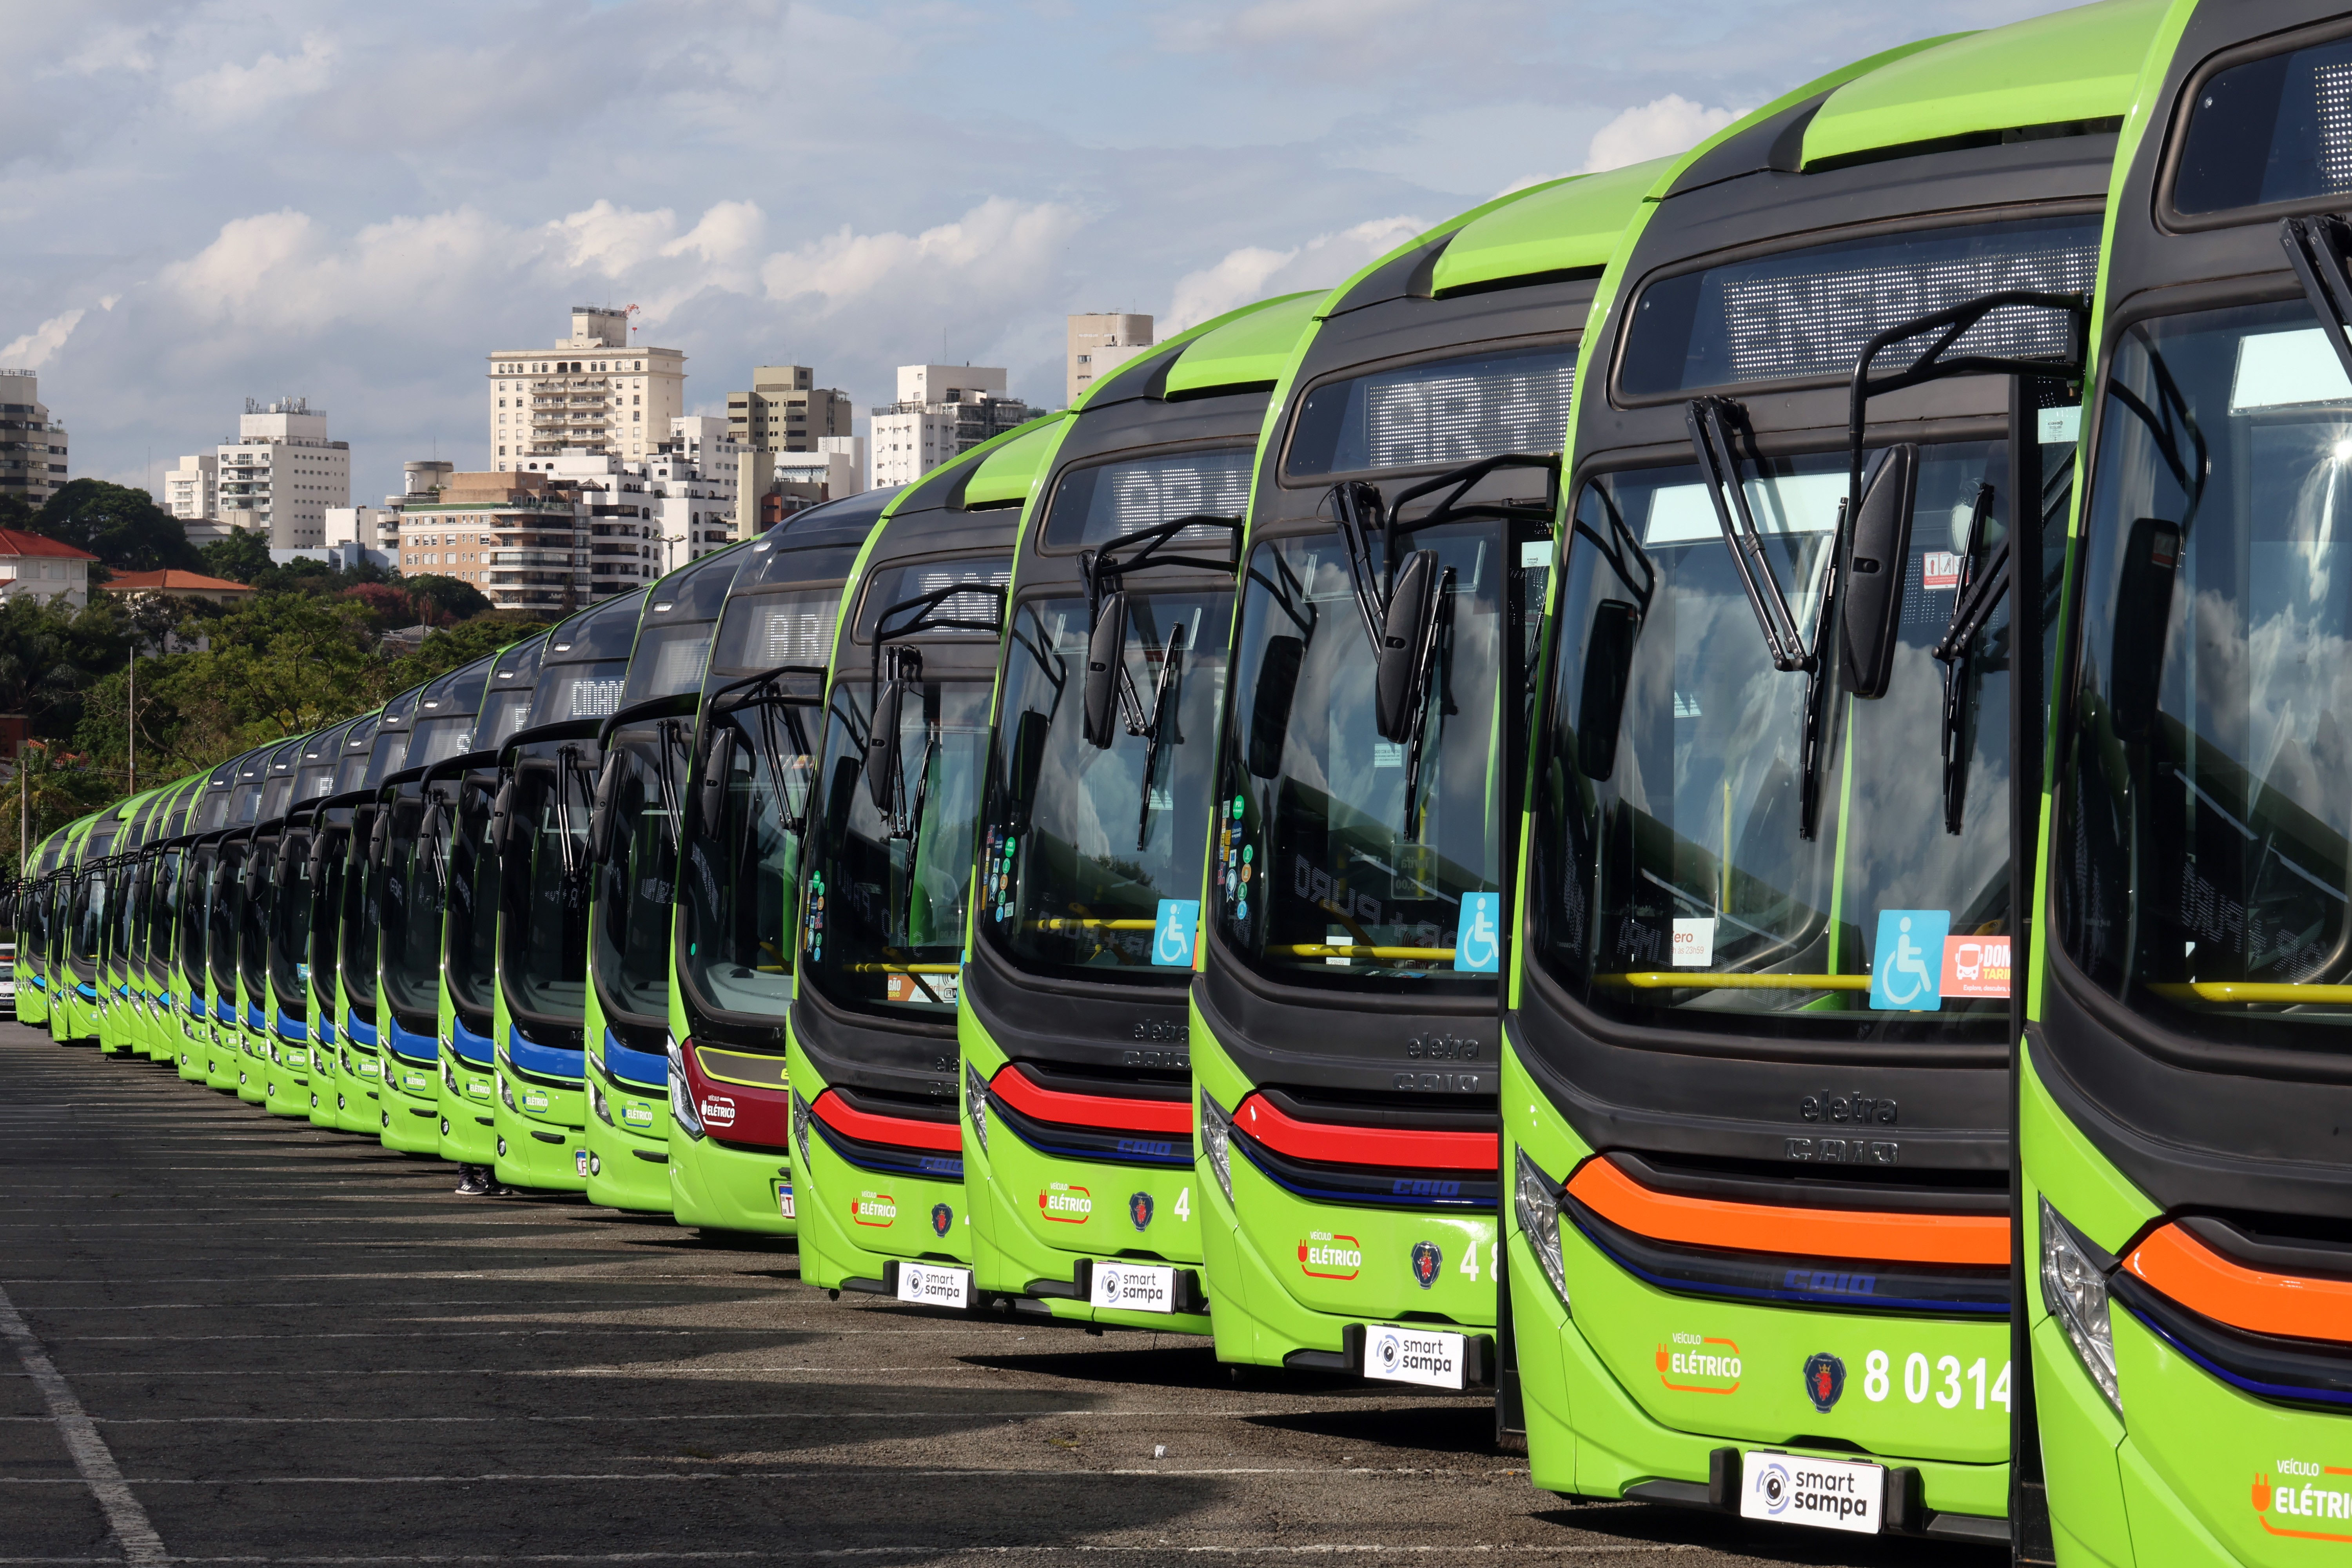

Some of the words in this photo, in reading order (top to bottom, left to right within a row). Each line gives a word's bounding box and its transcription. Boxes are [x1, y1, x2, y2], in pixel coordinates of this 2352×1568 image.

[1379, 377, 1481, 466] AR
[1121, 468, 1203, 538] AR
[770, 614, 819, 657] AR
[1672, 931, 1693, 943] ero
[1134, 1018, 1190, 1043] eletra
[1406, 1032, 1479, 1061] eletra
[1123, 1051, 1191, 1069] CAIO
[407, 1076, 426, 1086] ELÉTRICO
[470, 1083, 490, 1094] ELÉTRICO
[1392, 1073, 1479, 1093] CAIO
[526, 1096, 548, 1107] ELÉTRICO
[707, 1103, 735, 1118] ELÉTRICO
[1800, 1089, 1898, 1125] eletra
[627, 1108, 652, 1121] ELÉTRICO
[1117, 1140, 1172, 1156] CAIO
[1784, 1138, 1900, 1164] CAIO
[1050, 1182, 1068, 1191] VEÍCULO
[1392, 1179, 1461, 1197] CAIO
[785, 1197, 792, 1214] T
[860, 1201, 897, 1218] ELÉTRICO
[1049, 1193, 1092, 1213] ELÉTRICO
[1174, 1187, 1190, 1221] 4
[1310, 1229, 1332, 1241] VEÍCULO
[1309, 1245, 1361, 1267] ELÉTRICO
[1460, 1240, 1479, 1281] 4
[926, 1274, 954, 1285] smart
[1124, 1273, 1156, 1286] smart
[1784, 1270, 1876, 1294] CAIO
[925, 1286, 960, 1300] sampa
[1123, 1287, 1163, 1303] sampa
[1403, 1340, 1443, 1354] smart
[1672, 1332, 1701, 1345] VEÍCULO
[1402, 1355, 1452, 1376] sampa
[1672, 1350, 1742, 1377] ELÉTRICO
[2277, 1458, 2319, 1477] VEÍCULO
[1795, 1469, 1855, 1492] smart
[1794, 1490, 1867, 1521] sampa
